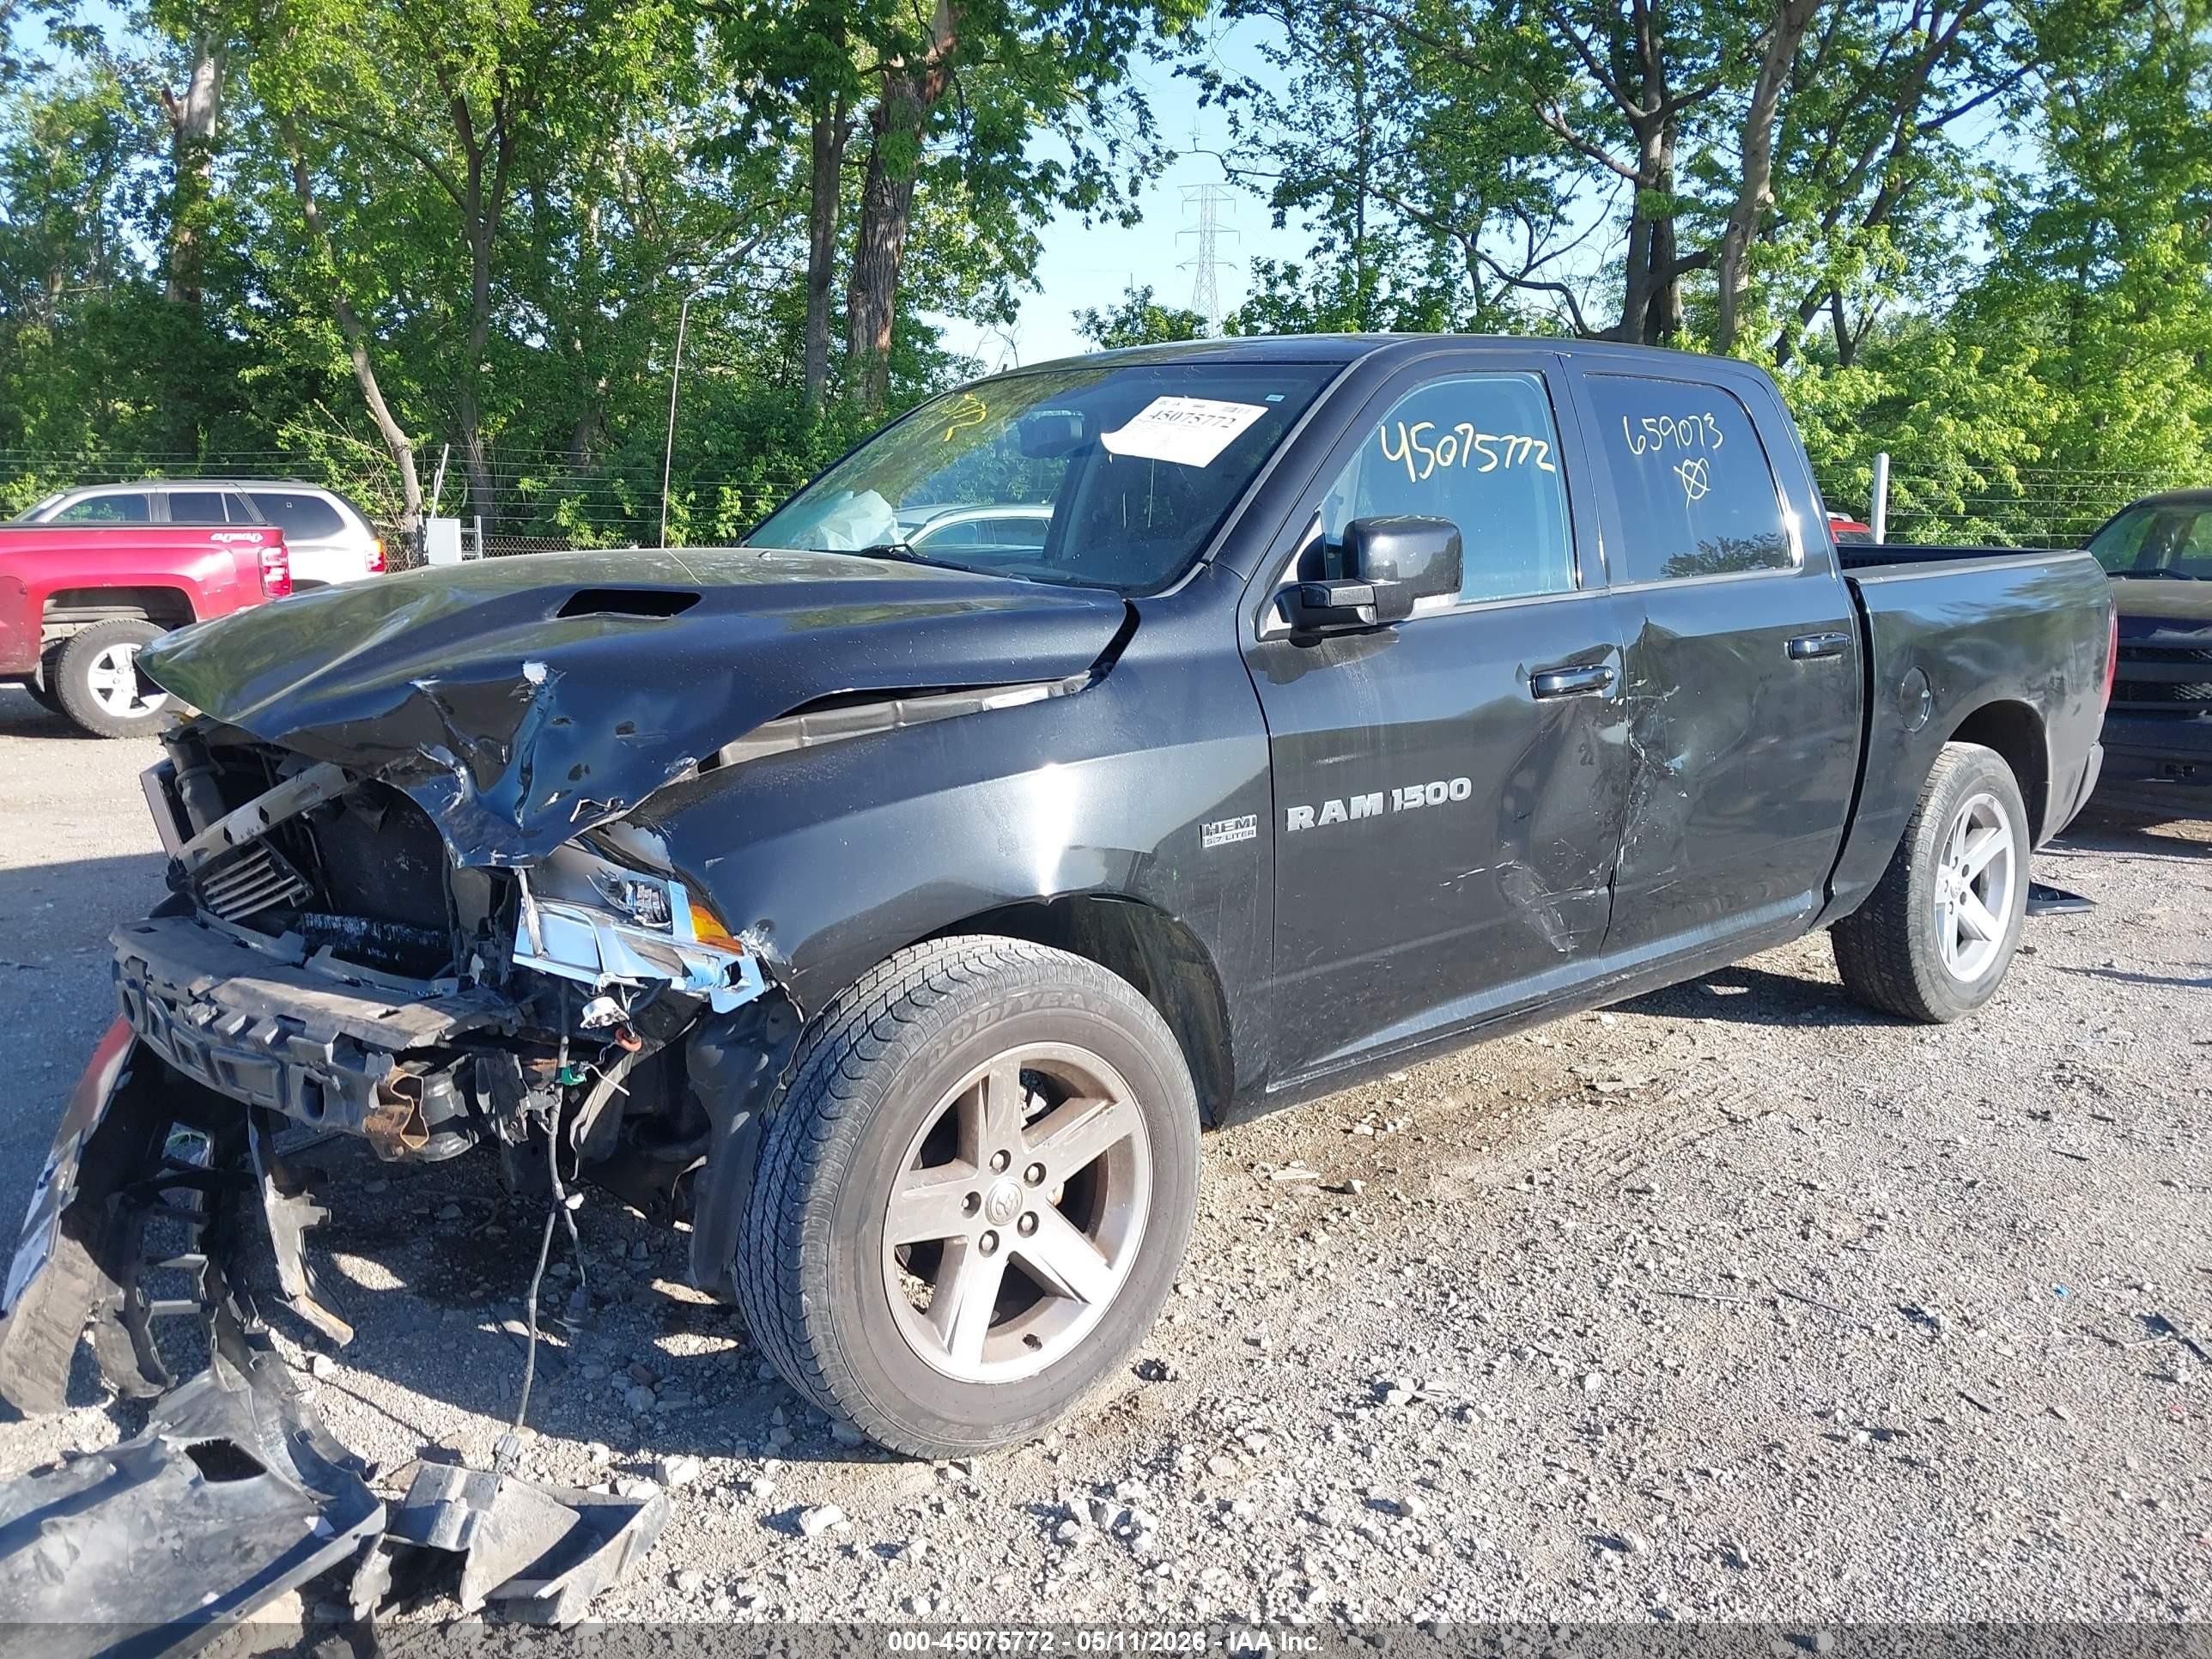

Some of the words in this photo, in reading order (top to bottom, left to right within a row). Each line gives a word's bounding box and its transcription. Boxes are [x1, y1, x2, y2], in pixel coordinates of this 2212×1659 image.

[1149, 410, 1237, 428] 45075772
[1622, 412, 1724, 455] 659073
[1380, 421, 1556, 483] 45075772
[1286, 791, 1384, 832] RAM
[1390, 776, 1473, 812] 1500
[1205, 817, 1257, 836] HEMI
[1225, 829, 1255, 841] LITER
